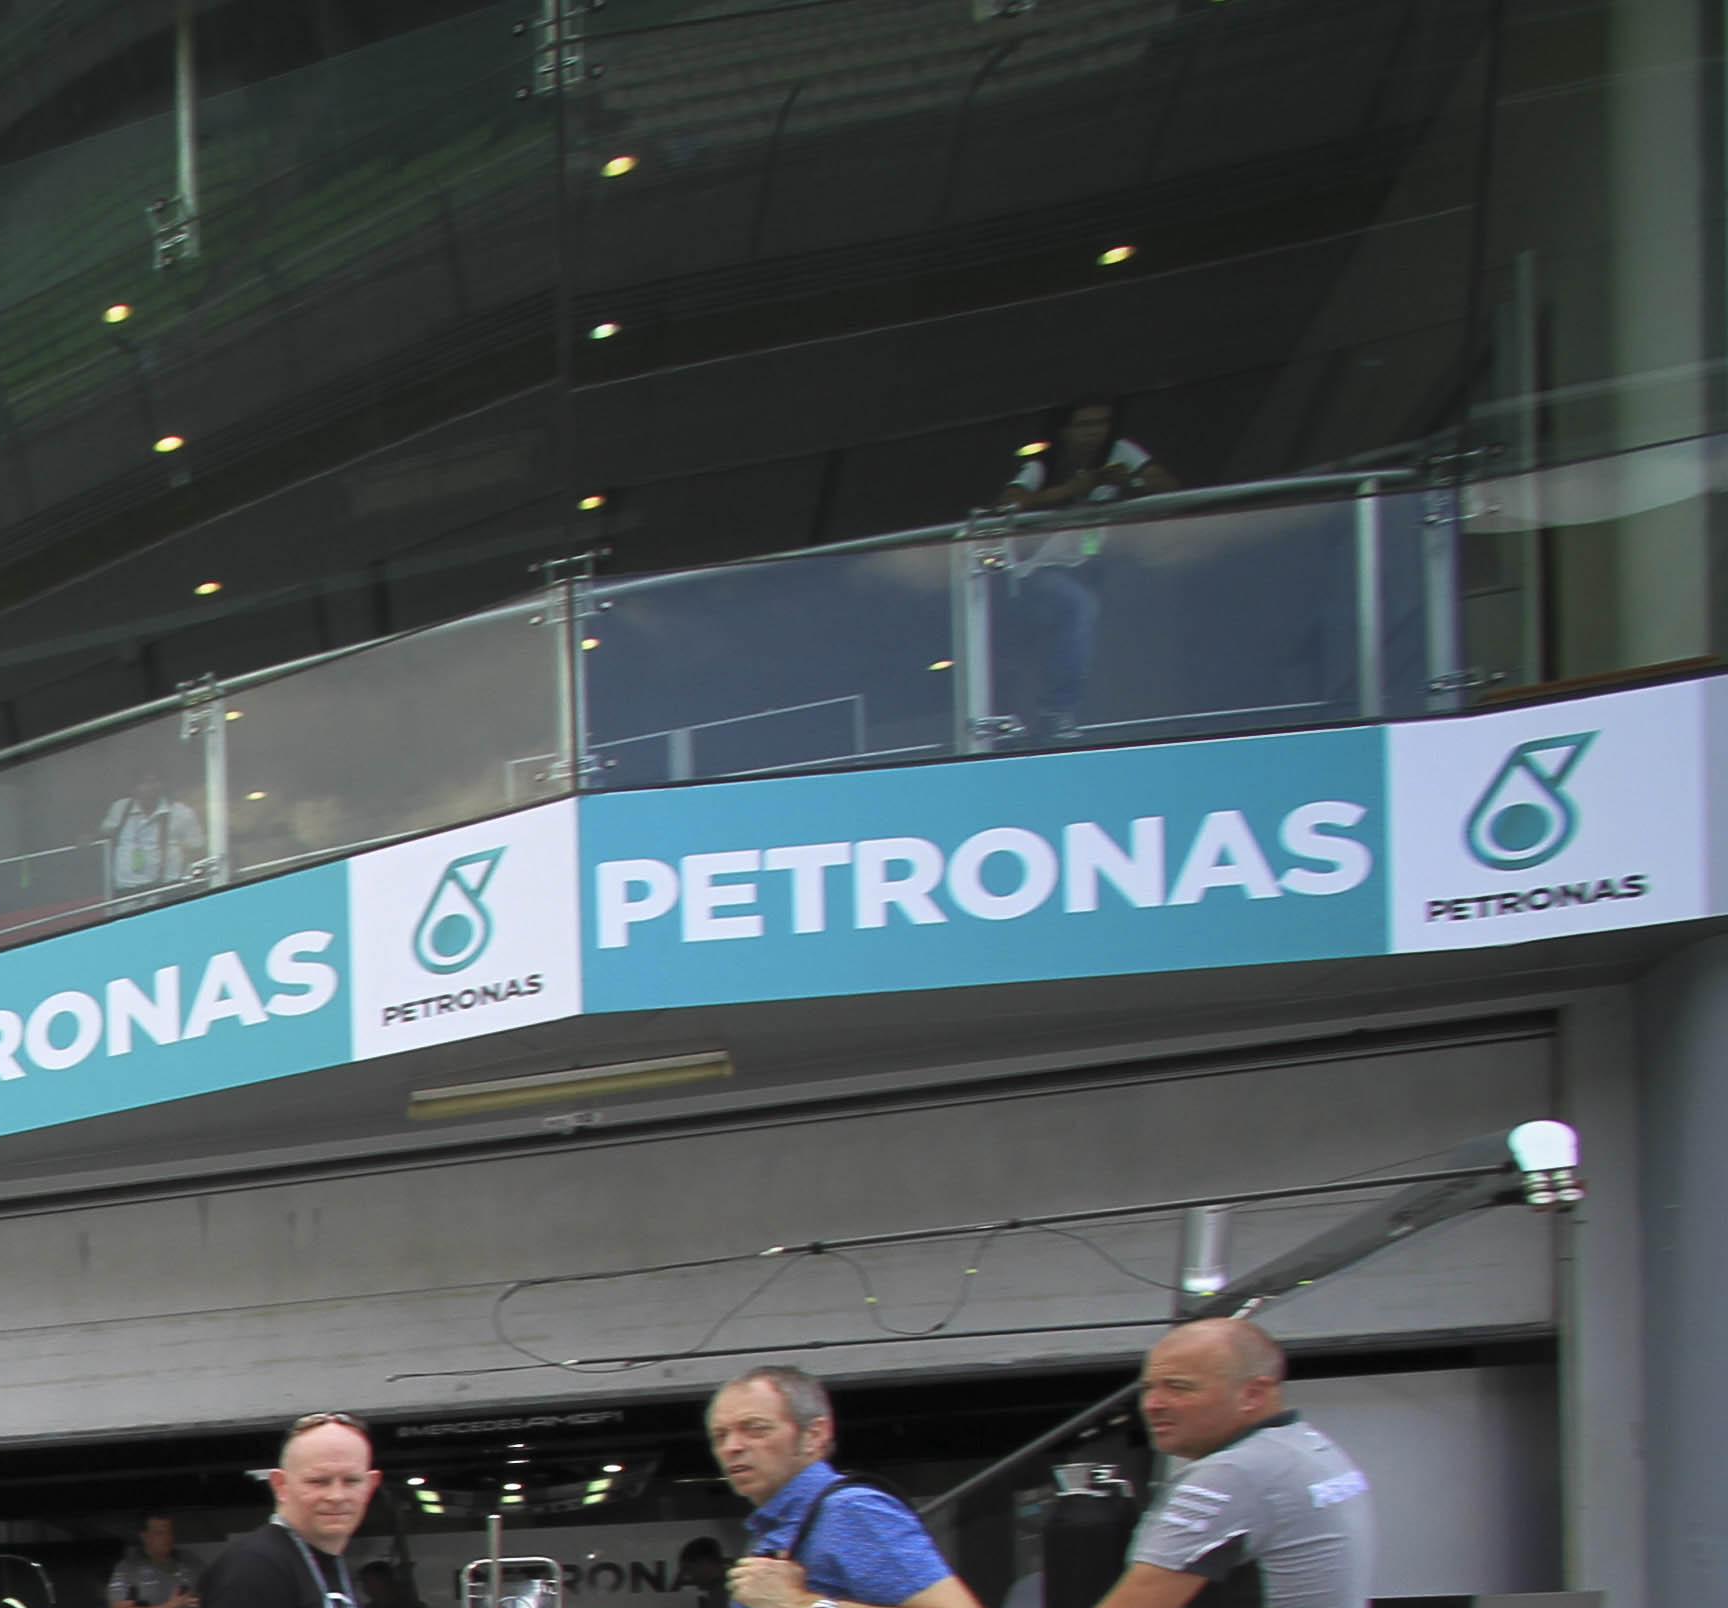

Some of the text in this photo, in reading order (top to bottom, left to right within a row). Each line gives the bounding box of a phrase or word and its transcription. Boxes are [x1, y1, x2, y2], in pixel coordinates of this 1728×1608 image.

[596, 800, 1373, 950] PETRONAS
[1424, 873, 1651, 924] PETRONAS
[380, 972, 545, 1029] PETRONAS
